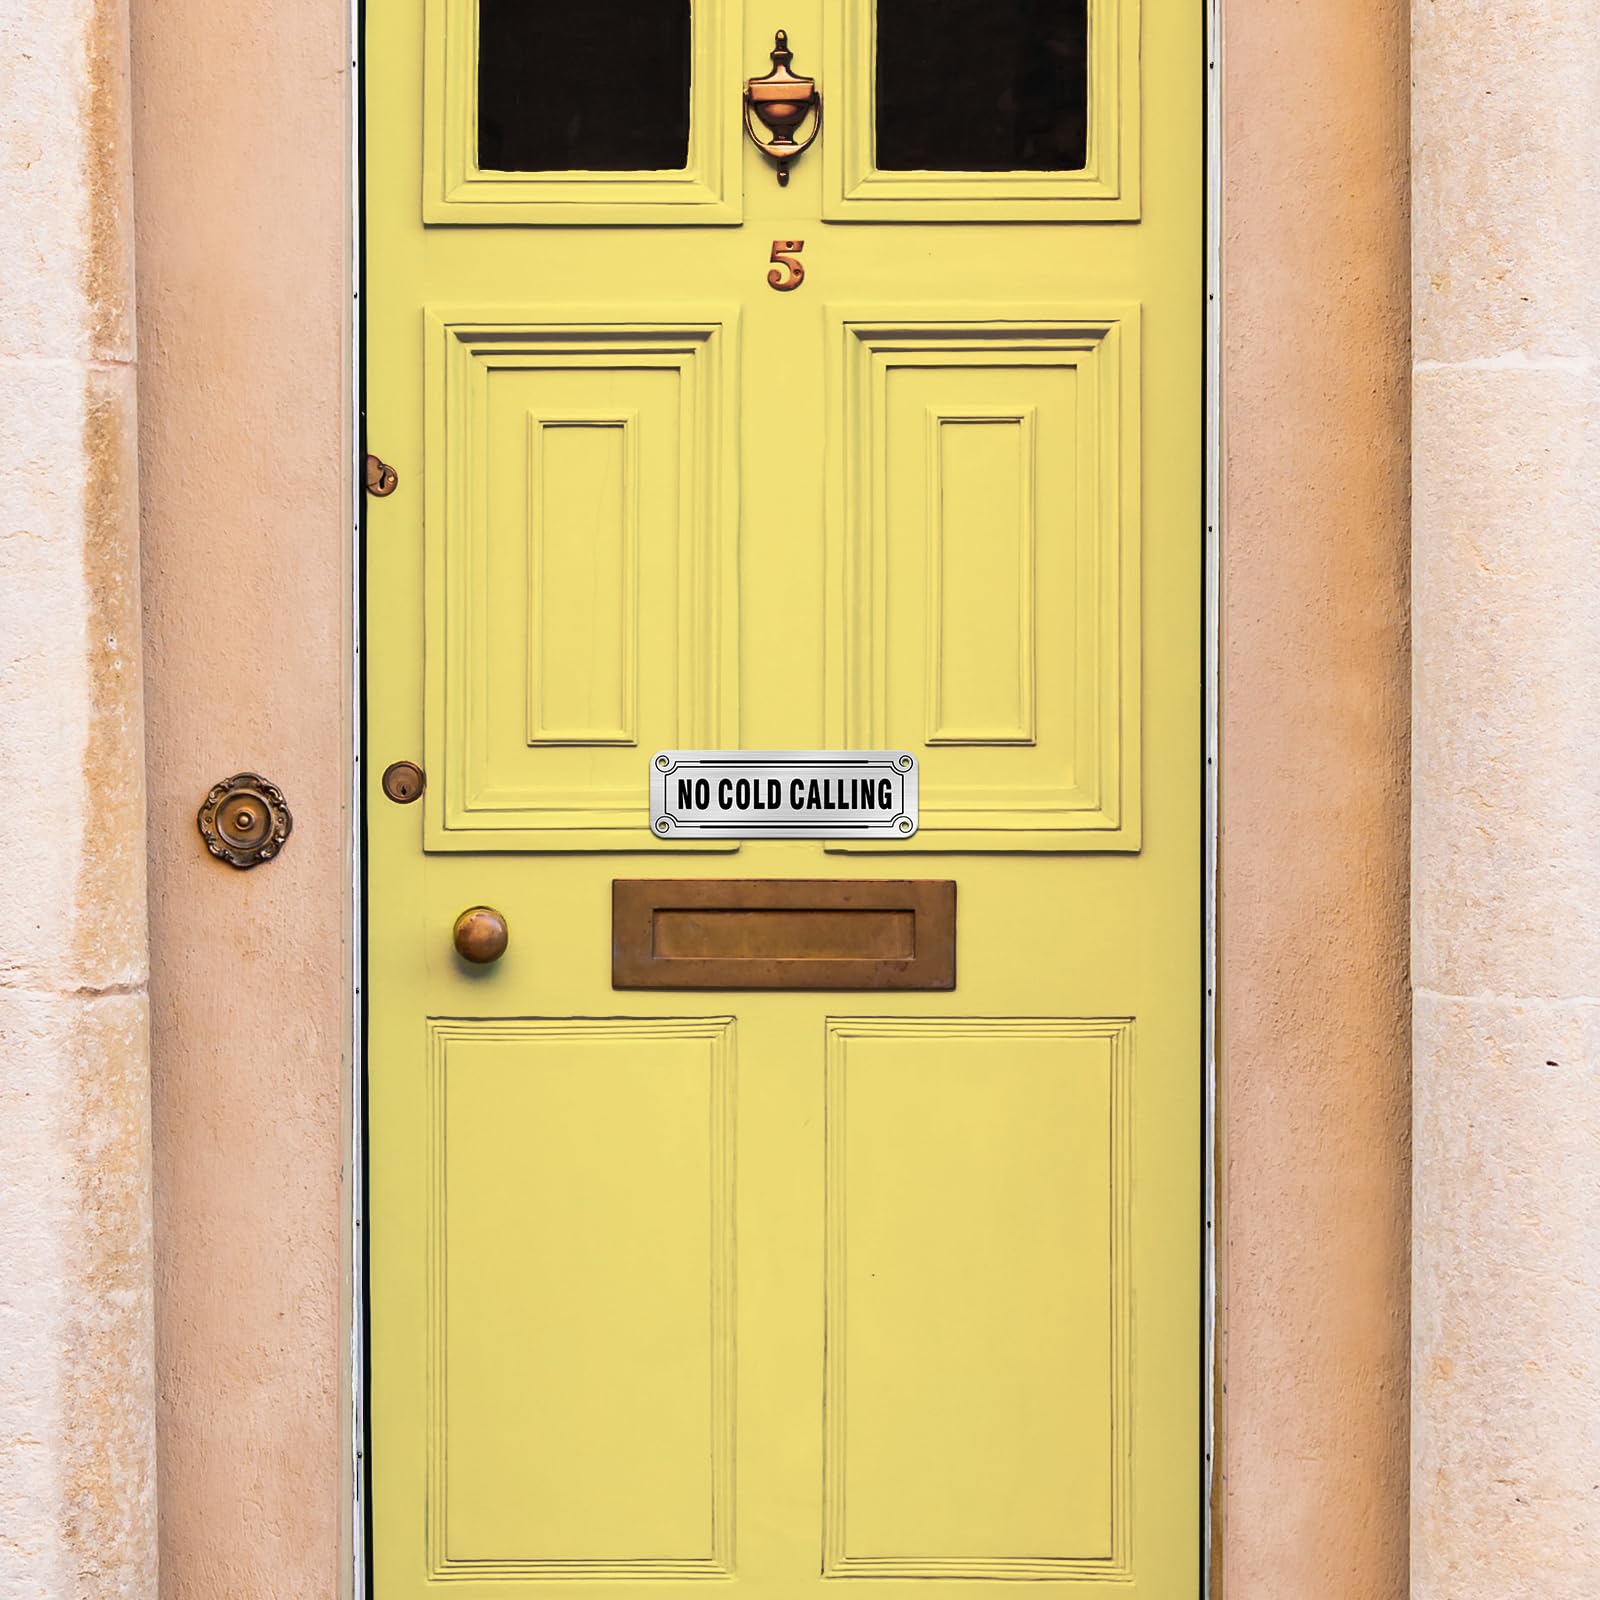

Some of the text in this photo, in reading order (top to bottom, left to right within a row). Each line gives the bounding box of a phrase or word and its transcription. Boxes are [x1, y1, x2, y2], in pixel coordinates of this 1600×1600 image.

[767, 240, 805, 292] 5
[678, 778, 892, 810] NO COLD CALLING
